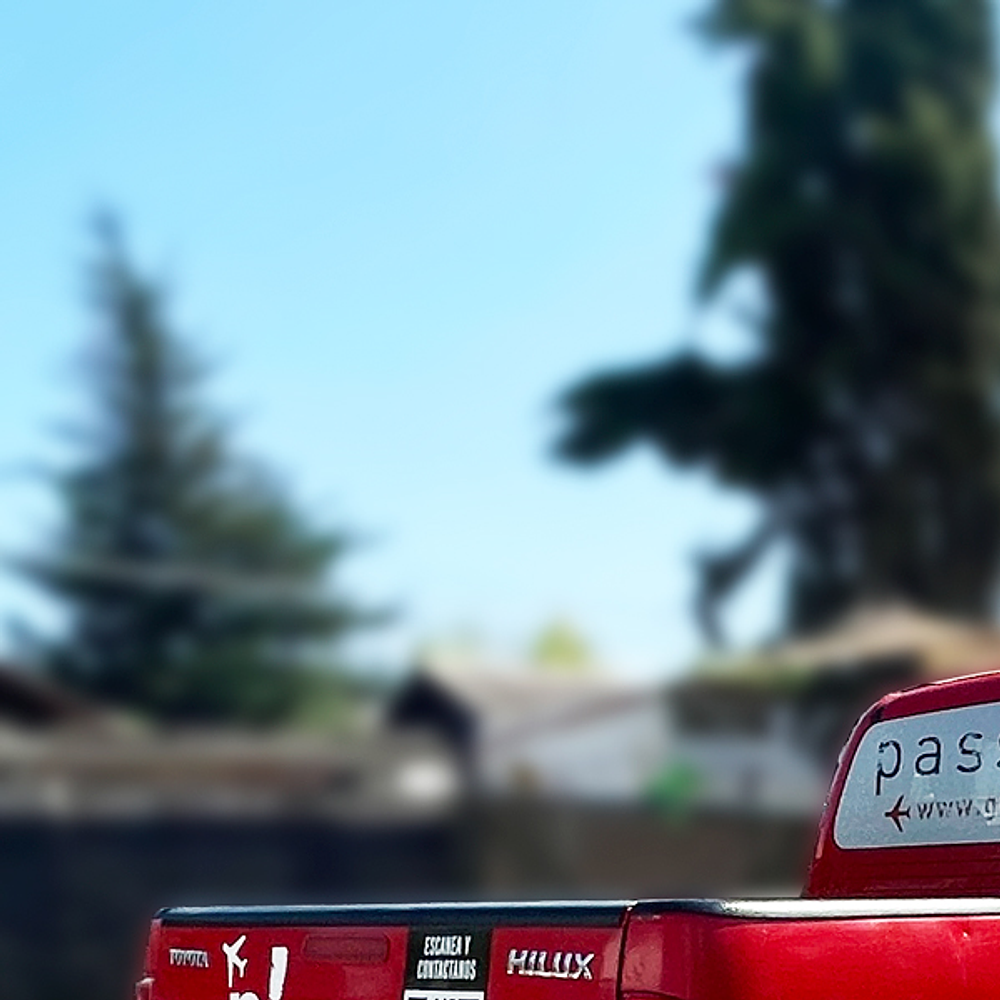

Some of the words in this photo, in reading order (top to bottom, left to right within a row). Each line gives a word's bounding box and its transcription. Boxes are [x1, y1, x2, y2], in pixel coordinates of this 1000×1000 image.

[424, 935, 462, 956] ESCANEA
[464, 935, 472, 956] Y
[507, 949, 594, 980] HILUX
